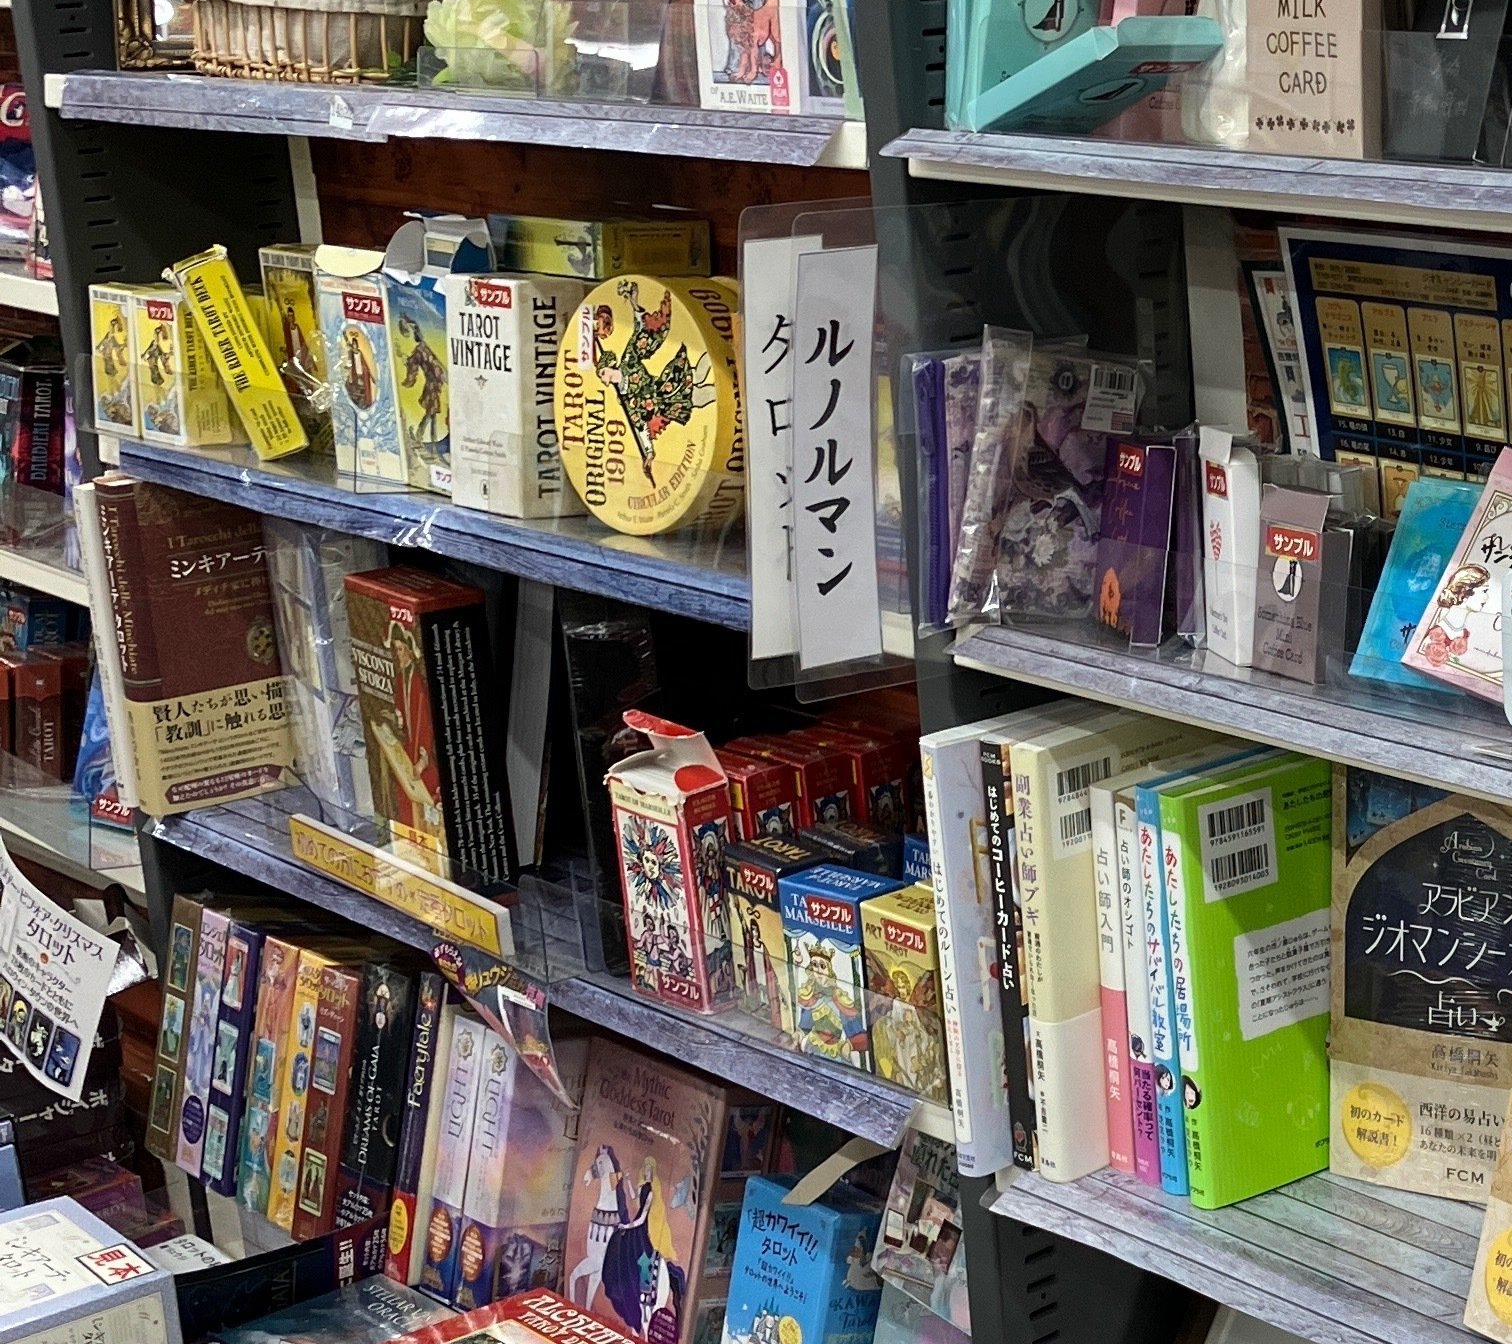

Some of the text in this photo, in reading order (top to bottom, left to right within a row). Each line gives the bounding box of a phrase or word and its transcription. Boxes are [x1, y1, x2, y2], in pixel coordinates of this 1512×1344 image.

[1266, 30, 1338, 58] COFFEE
[1279, 70, 1328, 94] CARD
[478, 283, 512, 306] サンプル
[458, 312, 501, 343] TAROT
[450, 337, 513, 374] VINTAGE
[533, 295, 557, 419] VINTAGE
[562, 348, 585, 450] TAROT
[585, 389, 607, 507] ORIGINAL
[606, 419, 626, 486] 1909
[805, 318, 854, 596] ルノルマン
[1272, 533, 1314, 557] サンプル
[352, 650, 396, 677] VISCONTI
[358, 668, 394, 695] SFORZA
[1015, 773, 1040, 928] 副業占い師ブギ
[1210, 825, 1266, 847] 9784591165591
[743, 867, 775, 892] サンプル
[810, 899, 852, 923] サンプル
[1095, 846, 1115, 956] 占い師入門
[886, 924, 924, 950] サンプル
[1163, 844, 1192, 1052] あたしたちの居場所
[661, 976, 700, 1000] サンプル
[1426, 990, 1480, 1032] 占い
[408, 1010, 432, 1110] Faerytale
[1349, 1101, 1407, 1128] 初のカード
[85, 1248, 146, 1280] 見本
